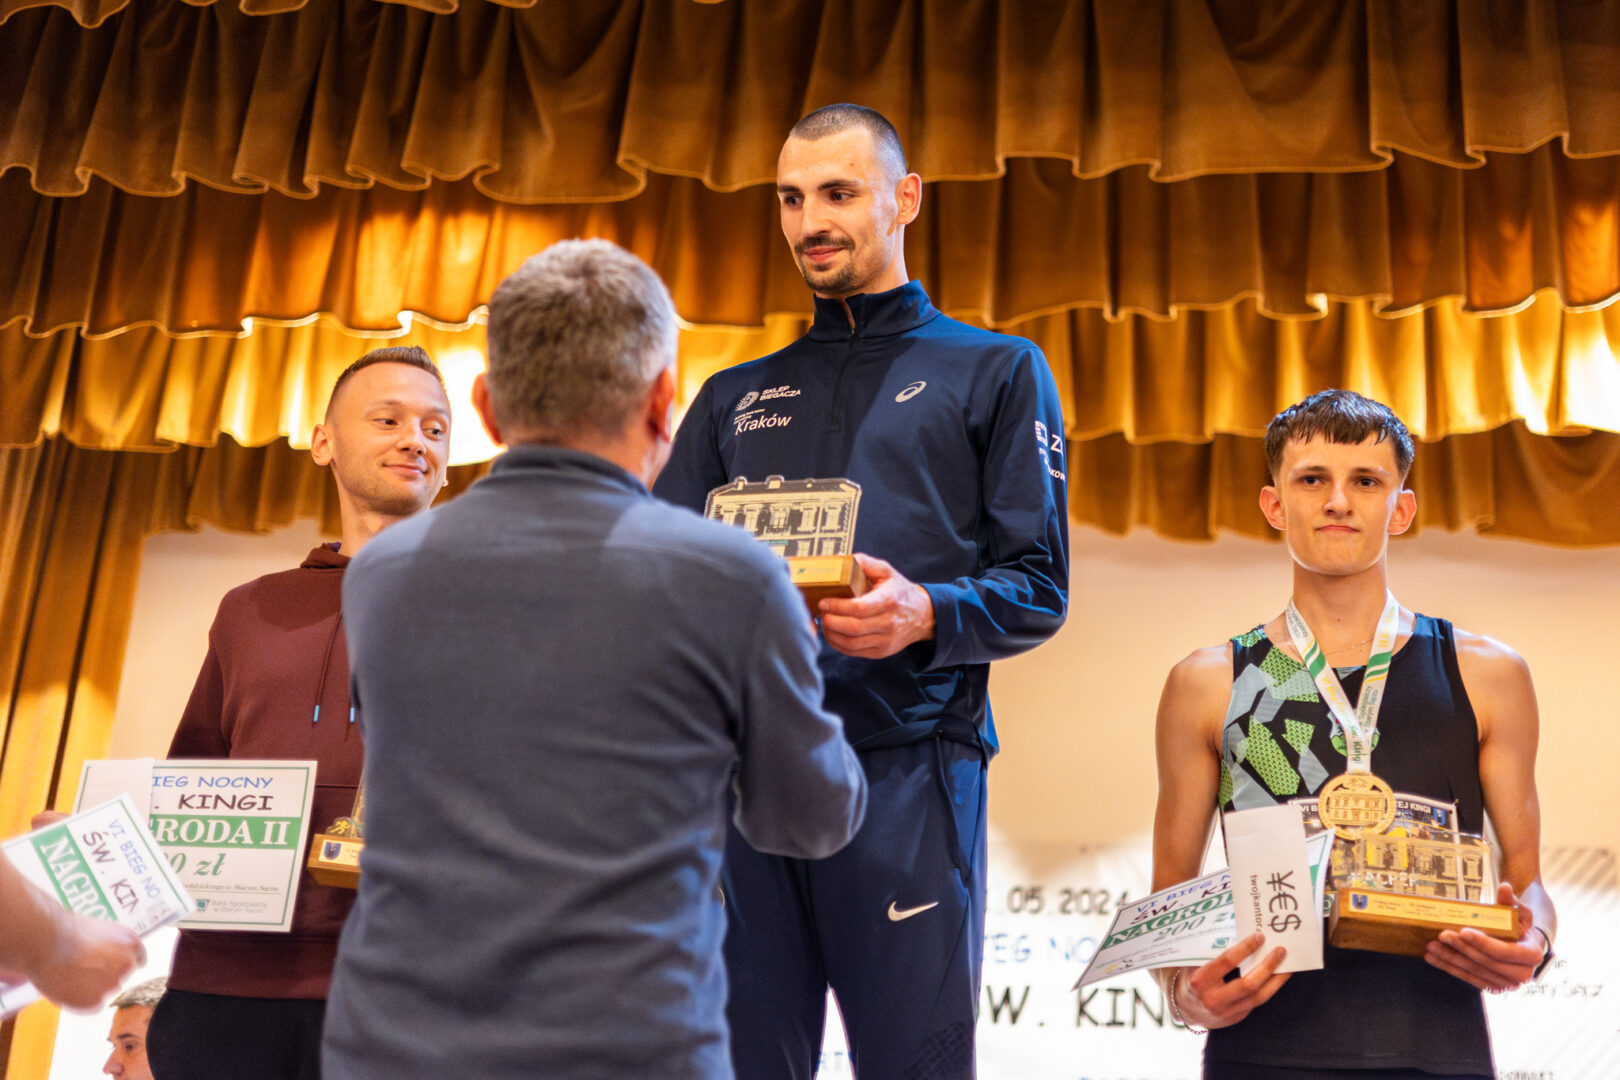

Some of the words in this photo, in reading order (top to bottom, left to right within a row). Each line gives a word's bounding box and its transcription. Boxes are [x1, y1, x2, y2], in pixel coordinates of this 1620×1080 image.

[734, 413, 792, 436] Kraków
[151, 776, 189, 788] IEG
[198, 776, 273, 788] NOCNY
[177, 794, 274, 811] KINGI
[150, 818, 254, 845] RODA
[260, 821, 291, 845] II
[82, 831, 116, 875] ŚW.
[110, 878, 139, 913] KIN
[108, 819, 127, 840] VI
[119, 840, 148, 875] BIEG
[140, 876, 161, 898] NO
[163, 852, 187, 875] 0
[194, 853, 226, 877] zł
[38, 835, 113, 921] NAGRO
[1200, 881, 1232, 899] KI
[1152, 914, 1207, 942] 200
[1049, 936, 1101, 964] NO
[977, 985, 1045, 1027] W.
